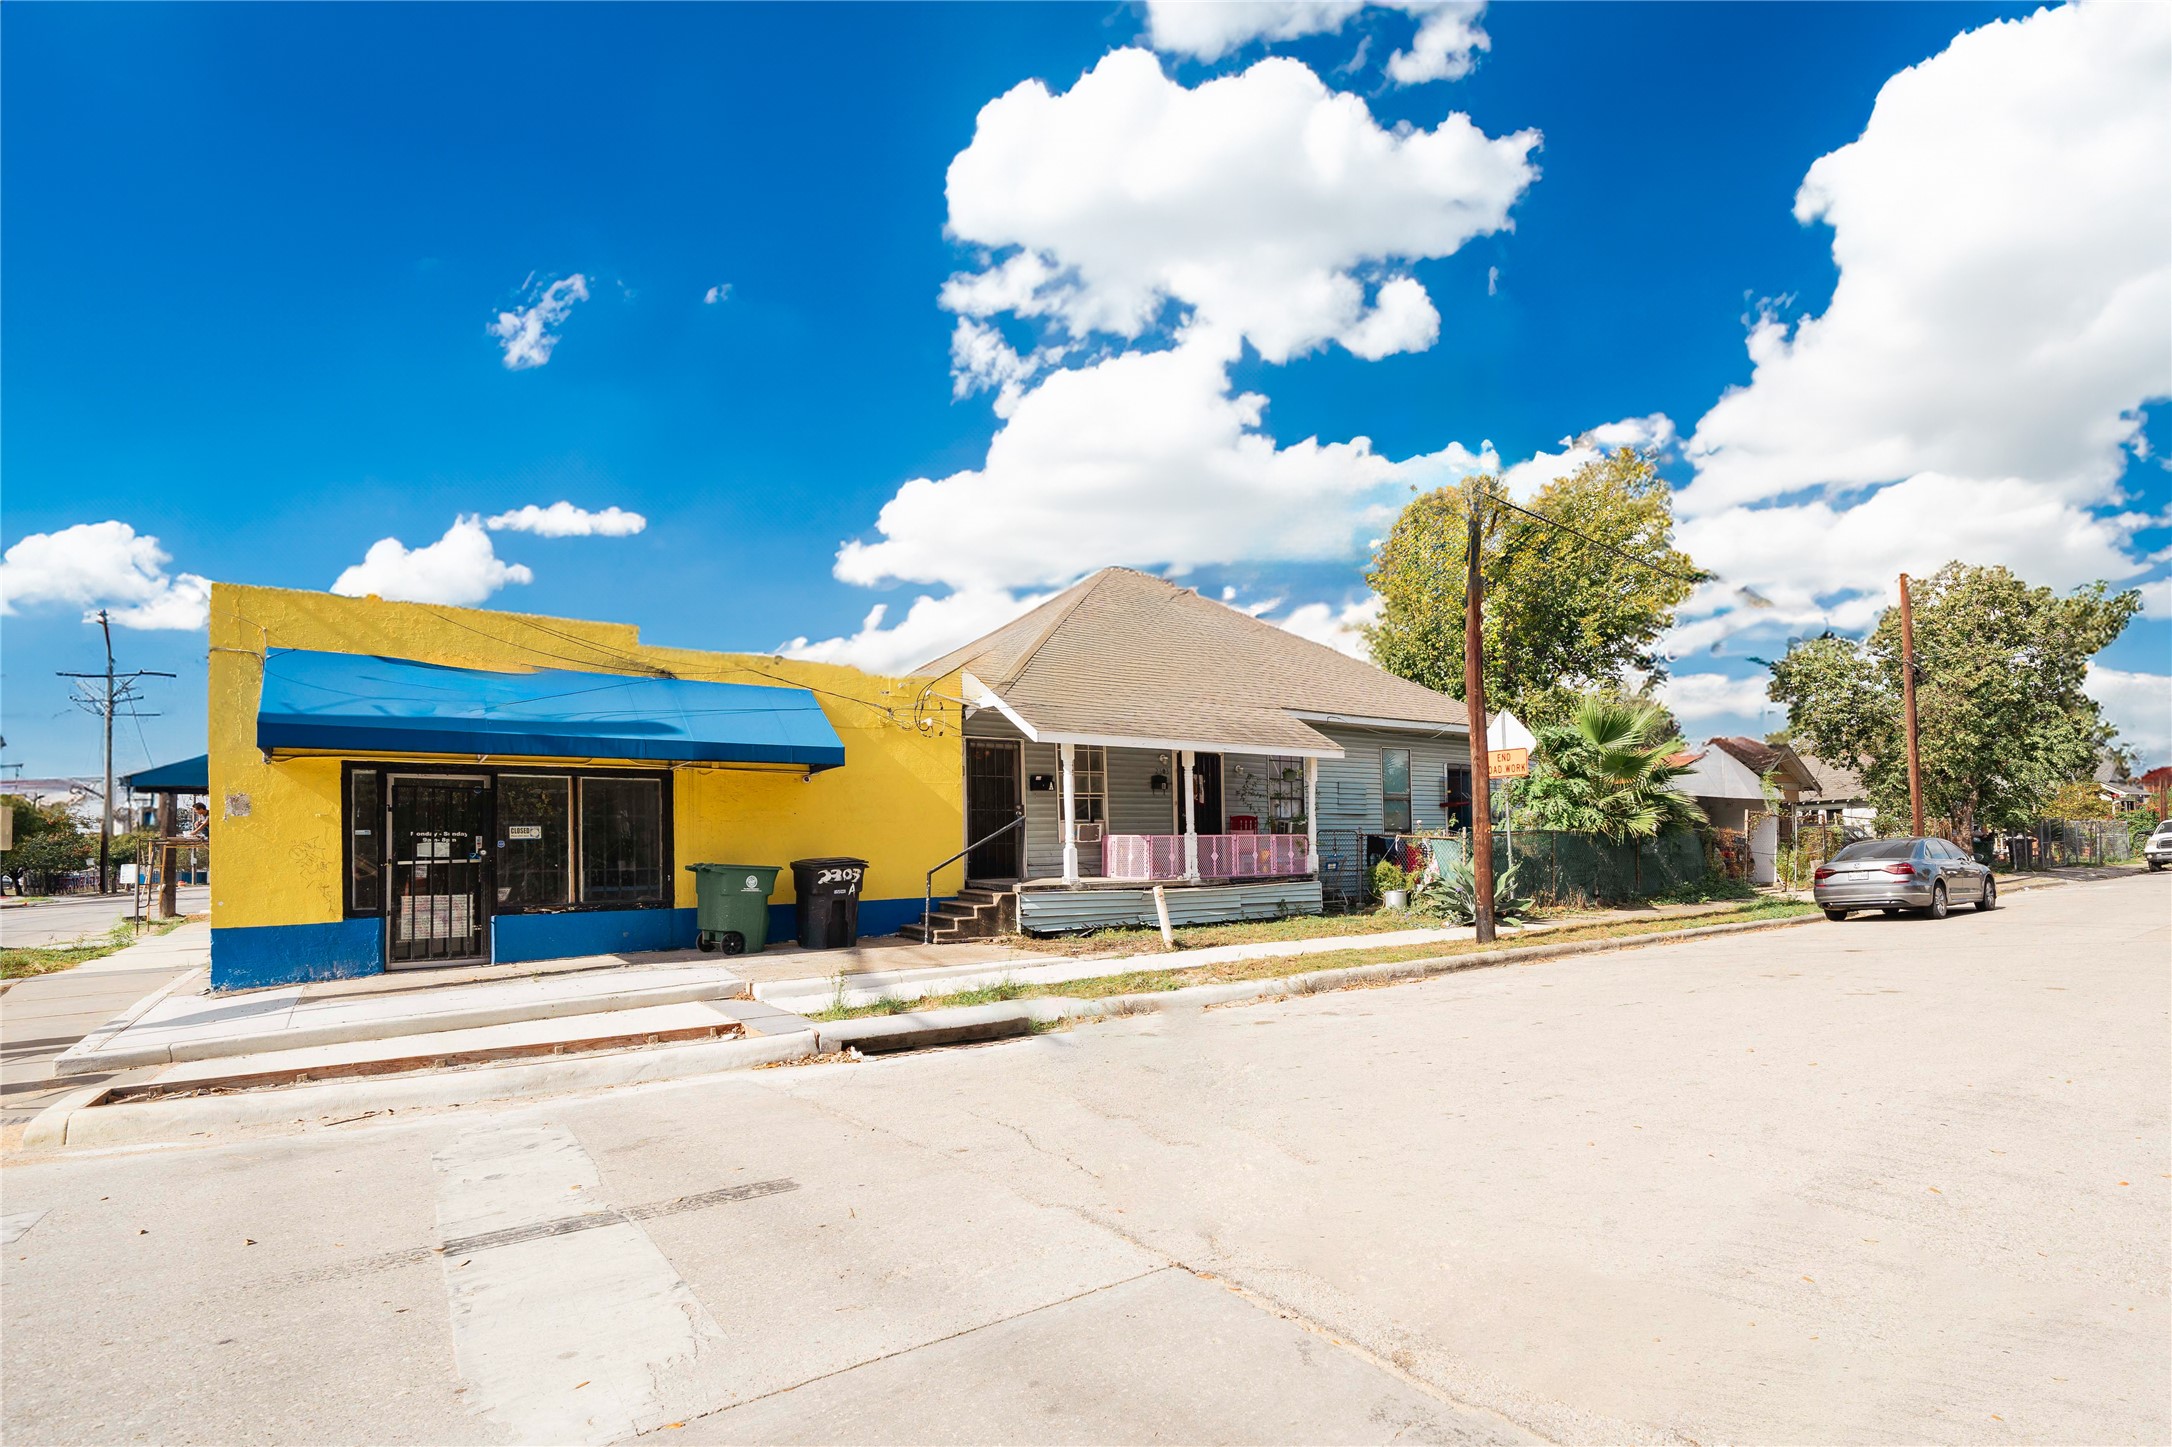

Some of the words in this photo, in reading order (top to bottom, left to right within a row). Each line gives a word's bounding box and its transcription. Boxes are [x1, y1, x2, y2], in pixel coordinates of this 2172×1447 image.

[1497, 753, 1511, 762] END
[1488, 765, 1502, 774] OAD
[1505, 763, 1526, 772] WORK
[848, 883, 856, 898] A
